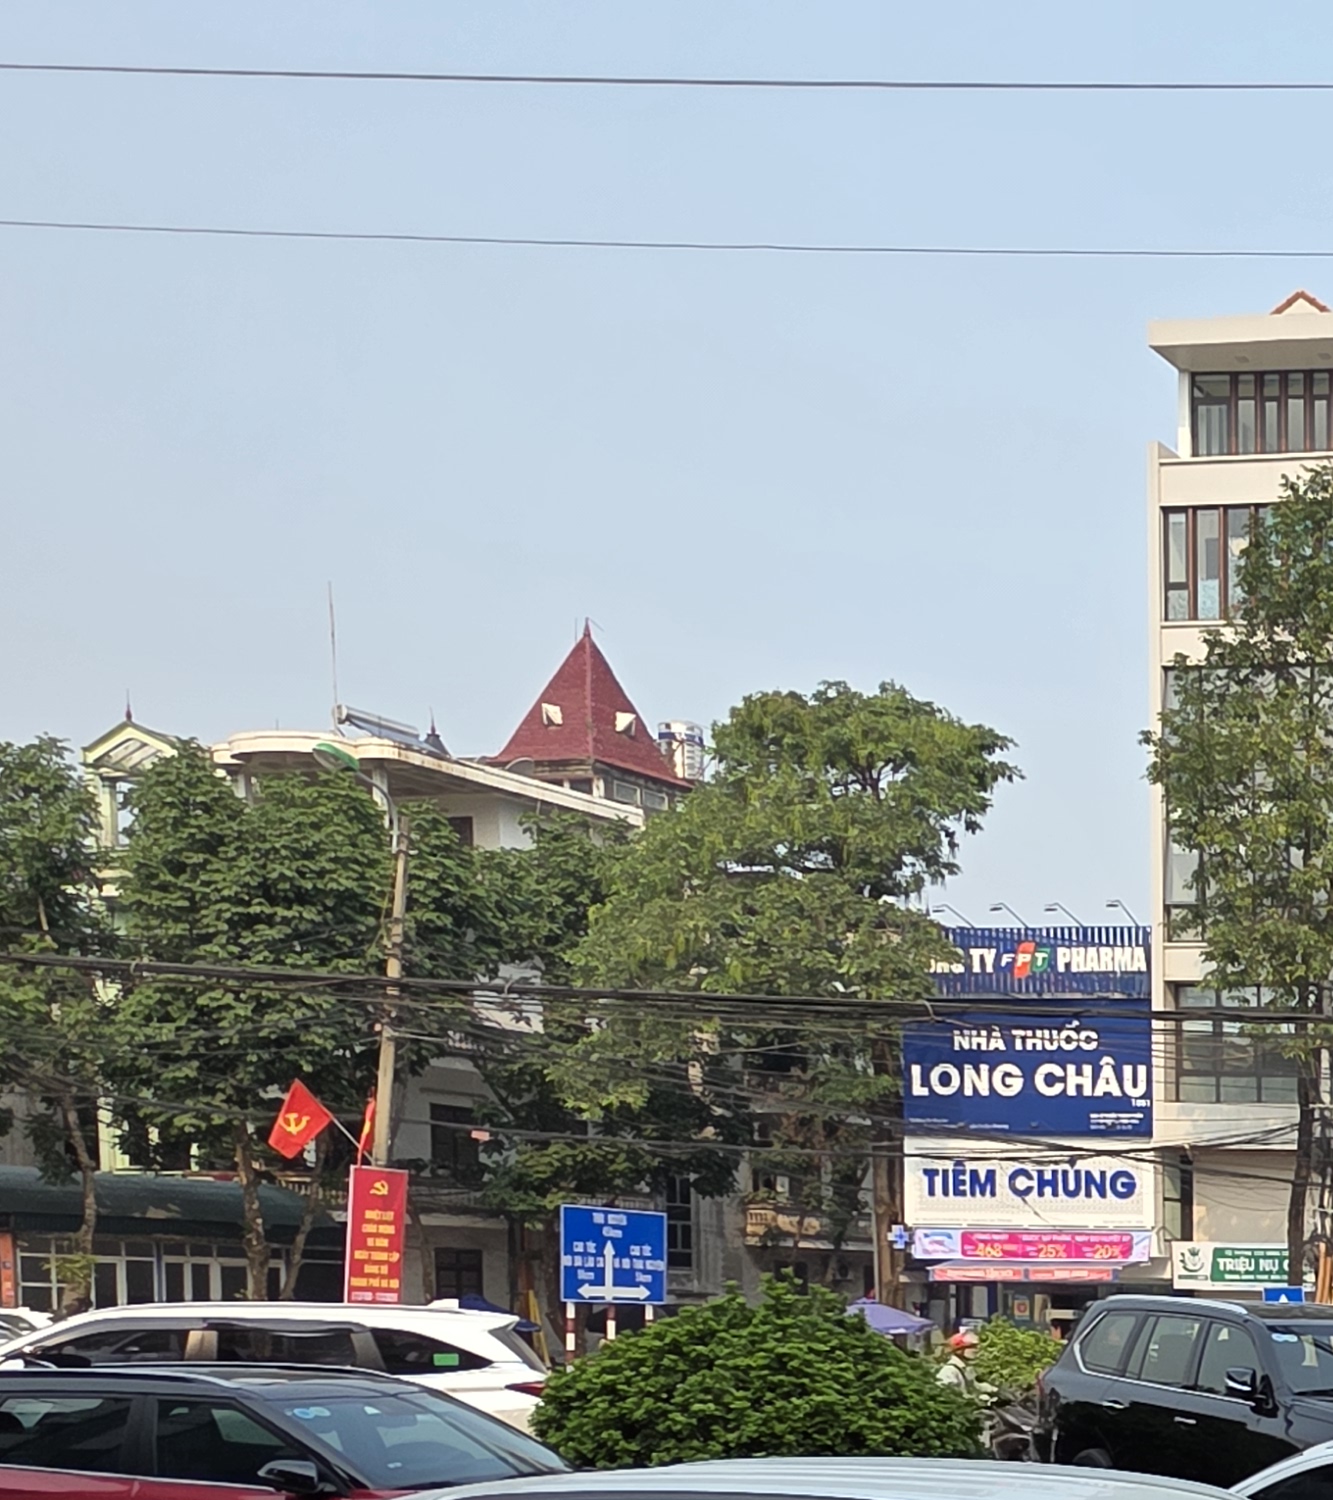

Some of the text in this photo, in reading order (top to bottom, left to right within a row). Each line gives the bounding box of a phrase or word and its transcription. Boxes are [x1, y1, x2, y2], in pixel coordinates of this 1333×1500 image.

[969, 948, 997, 973] TY
[1001, 950, 1049, 969] FPT
[1056, 946, 1148, 973] PHARMA
[952, 1019, 1099, 1051] NHÀ THUỐC
[910, 1055, 1148, 1098] LONG CHÂU
[922, 1161, 997, 1198] TIÊM
[1217, 1256, 1256, 1275] TRIỆU
